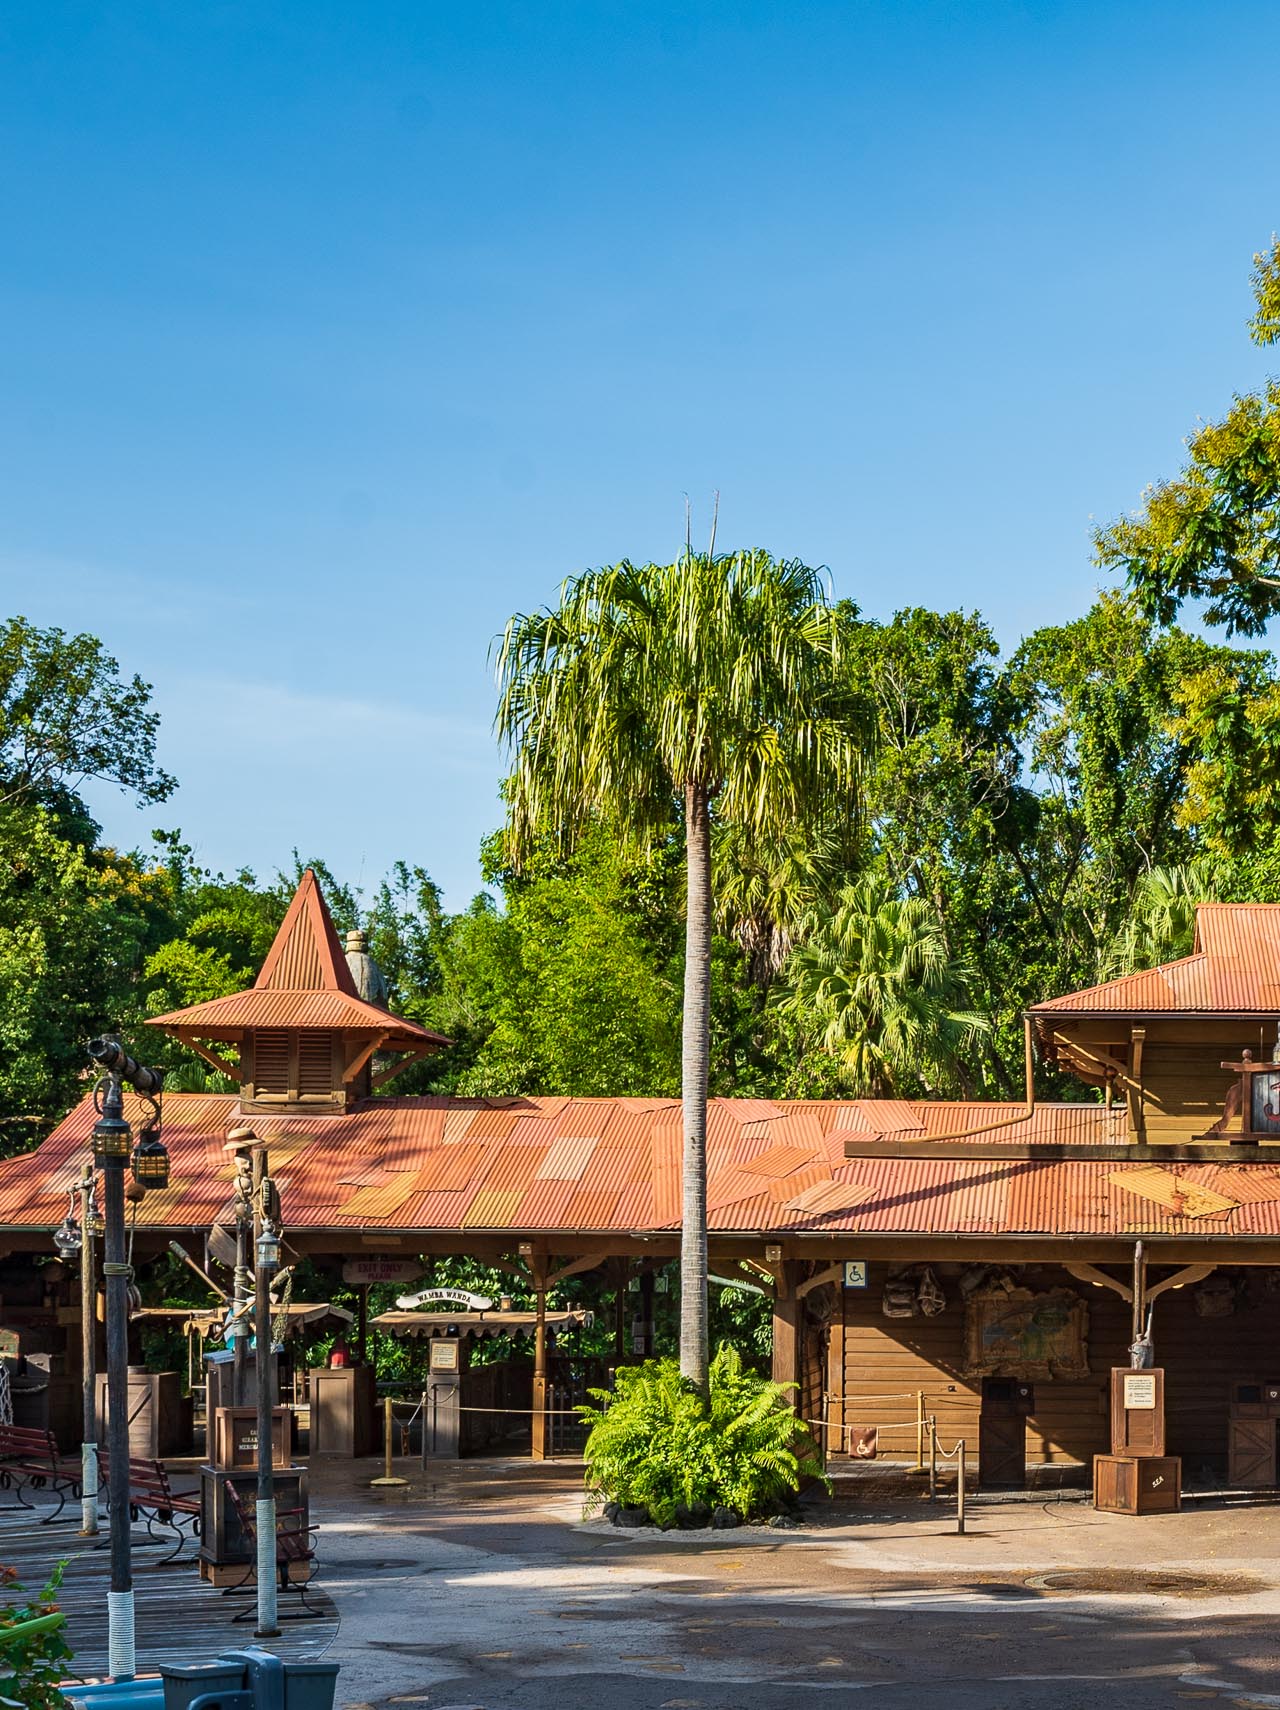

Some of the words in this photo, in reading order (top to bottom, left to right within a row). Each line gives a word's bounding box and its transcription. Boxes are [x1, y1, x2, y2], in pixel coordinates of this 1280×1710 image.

[358, 1263, 377, 1273] EXIT
[380, 1263, 403, 1273] ONLY
[417, 1291, 444, 1303] WAMBA
[446, 1291, 471, 1303] WANDA
